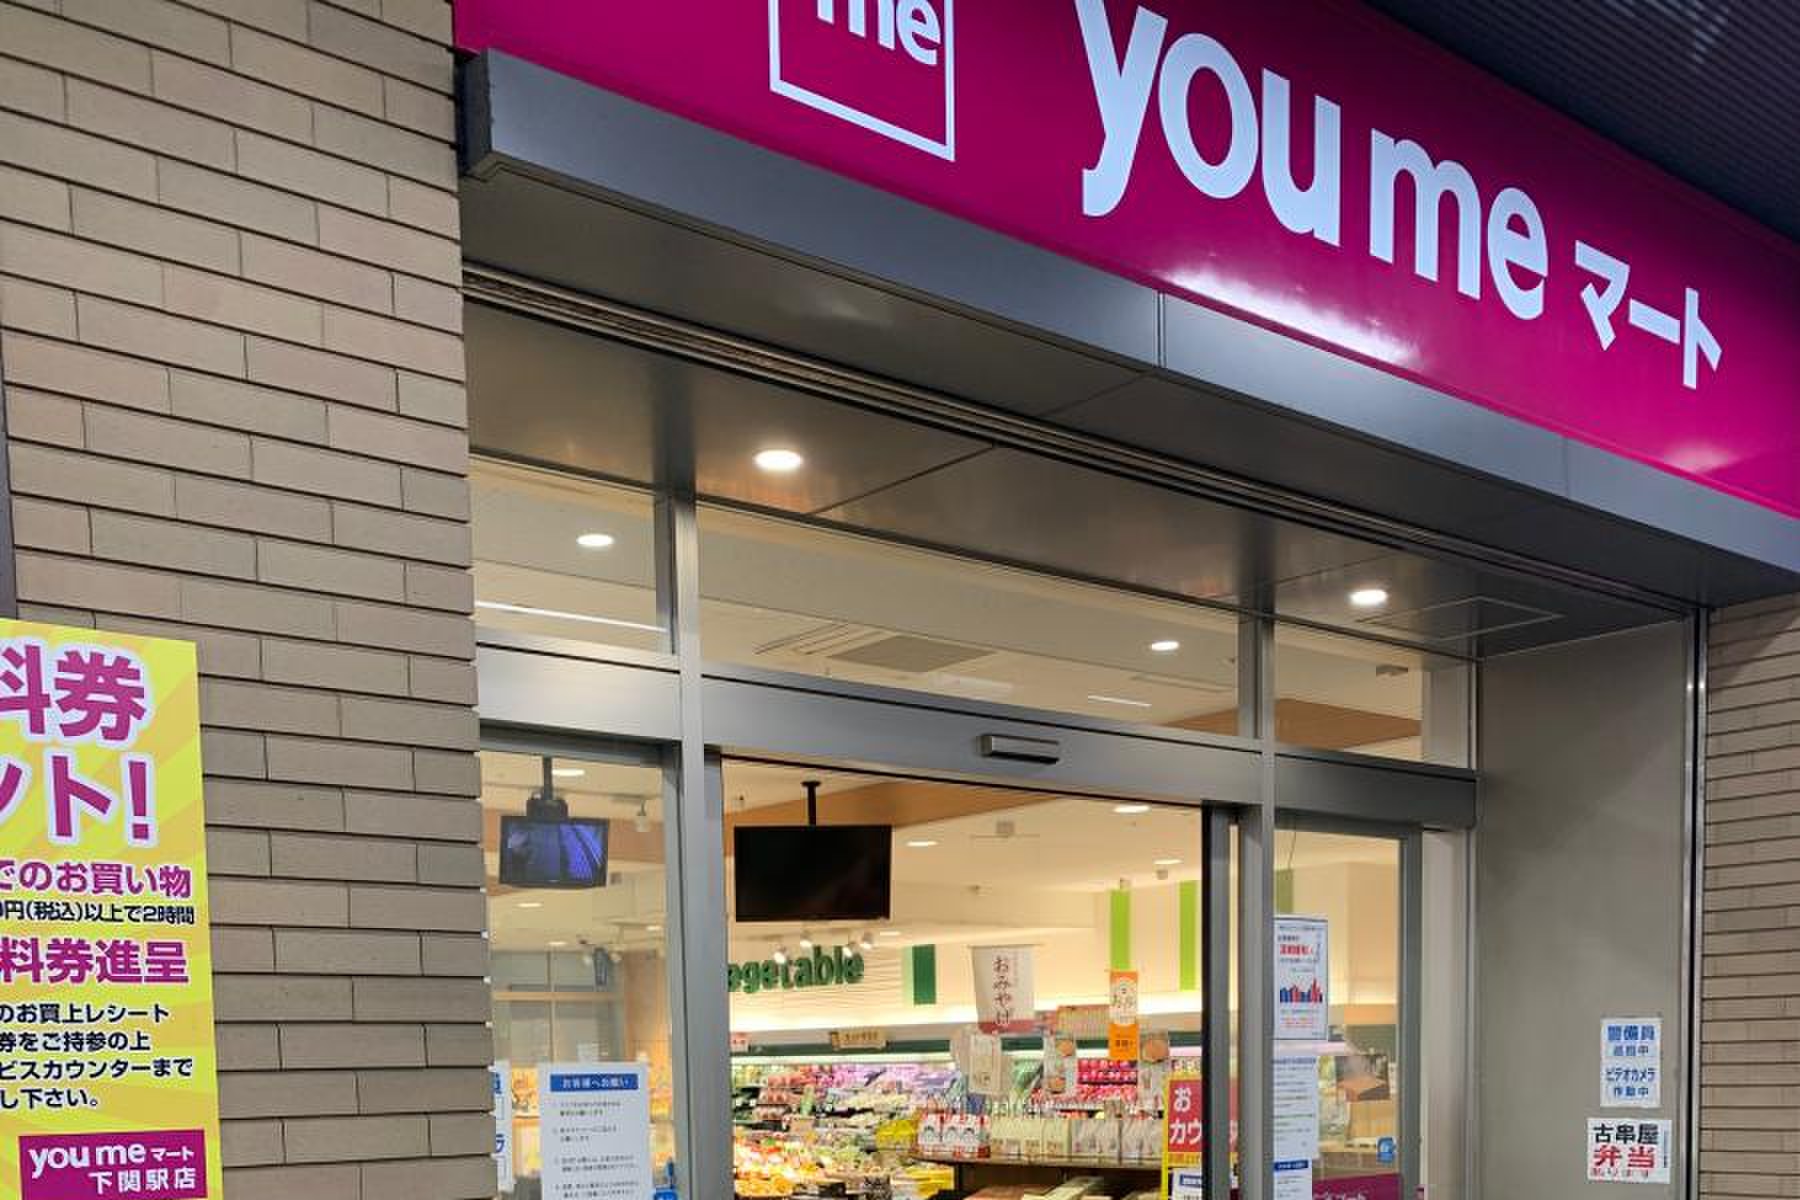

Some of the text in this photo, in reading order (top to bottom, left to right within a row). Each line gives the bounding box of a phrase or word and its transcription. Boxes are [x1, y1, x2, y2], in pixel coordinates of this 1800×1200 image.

[1075, 0, 1723, 391] you me マート
[0, 900, 195, 925] 円(税込)以上で2時間
[0, 937, 189, 983] 料券進呈
[1605, 1067, 1656, 1082] ビデオカメラ
[1593, 1122, 1659, 1145] 古串屋
[28, 1143, 195, 1179] you me マート
[1593, 1144, 1655, 1168] 弁当
[88, 1167, 197, 1195] 下関駅店
